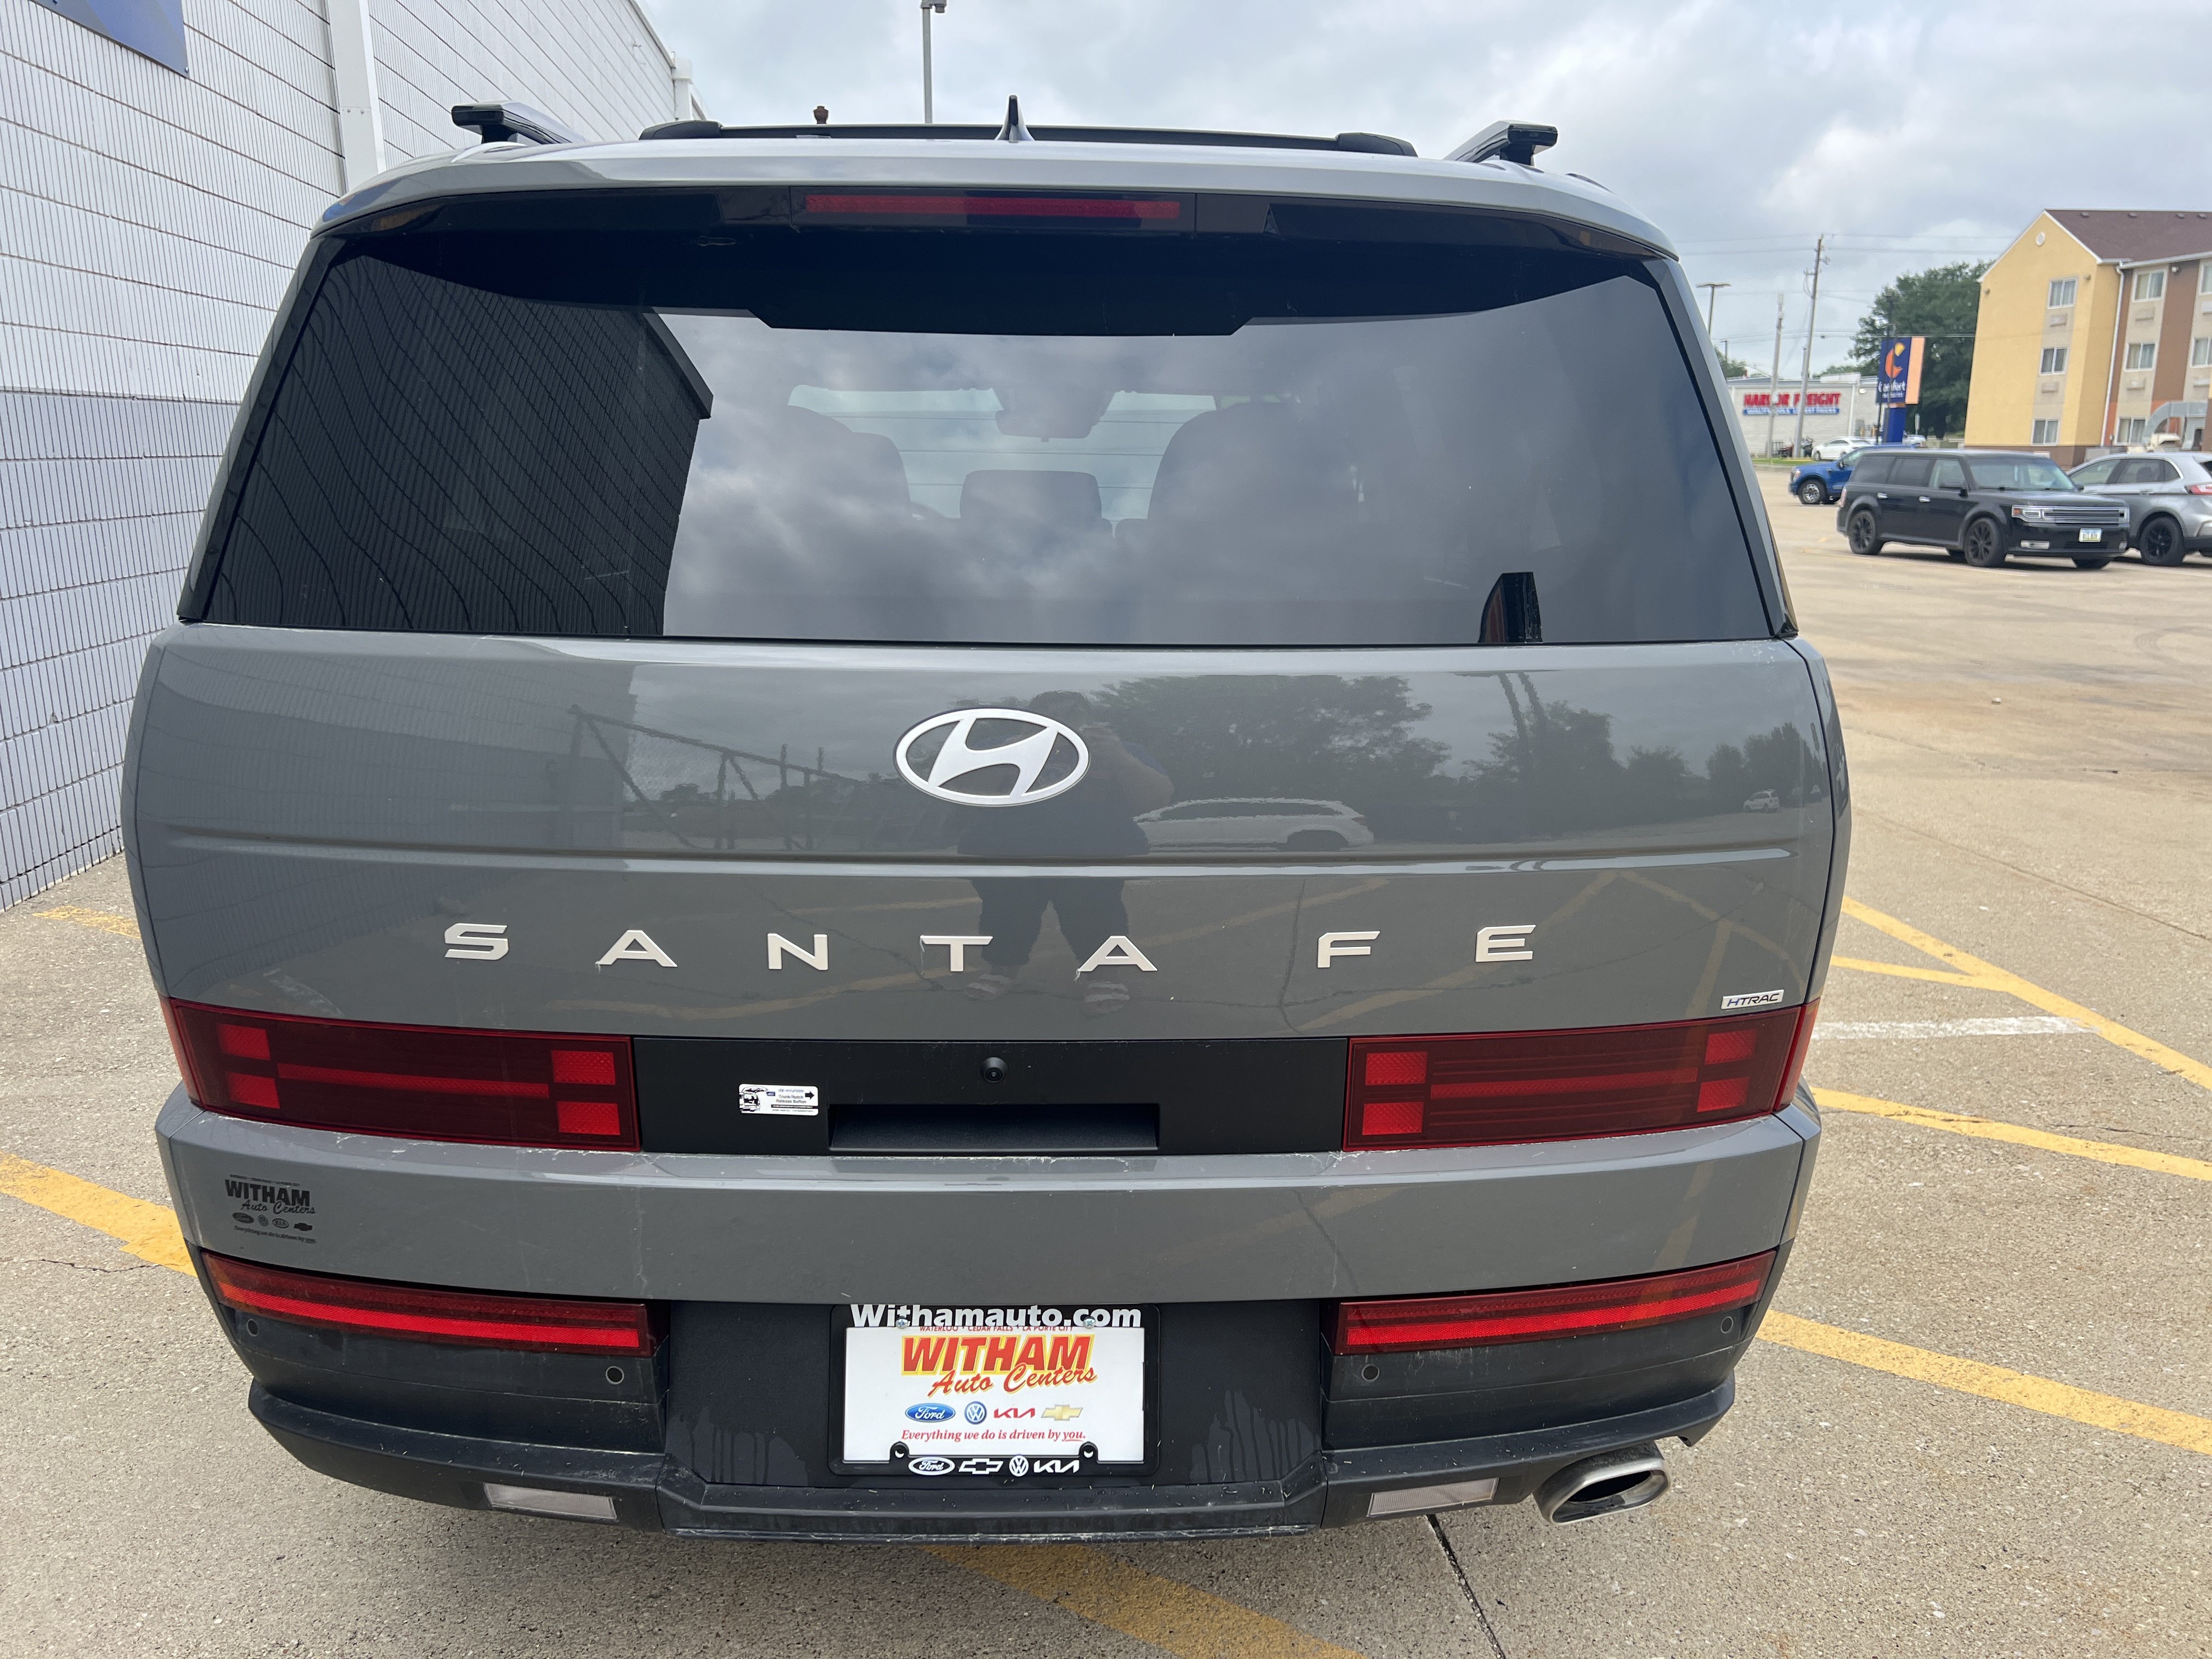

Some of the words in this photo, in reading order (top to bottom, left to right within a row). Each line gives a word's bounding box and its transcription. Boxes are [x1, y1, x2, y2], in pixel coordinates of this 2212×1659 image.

[1793, 393, 1841, 406] FEIGHT
[444, 923, 1158, 972] SANTA
[1317, 924, 1536, 968] FE
[1726, 993, 1780, 1007] HTRAC
[225, 1180, 310, 1207] WITHAM
[241, 1199, 269, 1212] Auto
[273, 1200, 317, 1215] Centers
[850, 1304, 1141, 1327] Withamauto.com
[902, 1335, 1094, 1375] WITHAM
[927, 1370, 994, 1398] Auto
[1003, 1363, 1098, 1393] Centers
[913, 1407, 945, 1420] Ford
[901, 1430, 962, 1442] Everything
[981, 1430, 995, 1440] do
[998, 1430, 1007, 1440] is
[1009, 1430, 1045, 1440] driven
[1047, 1430, 1060, 1442] by
[1062, 1432, 1086, 1442] you.
